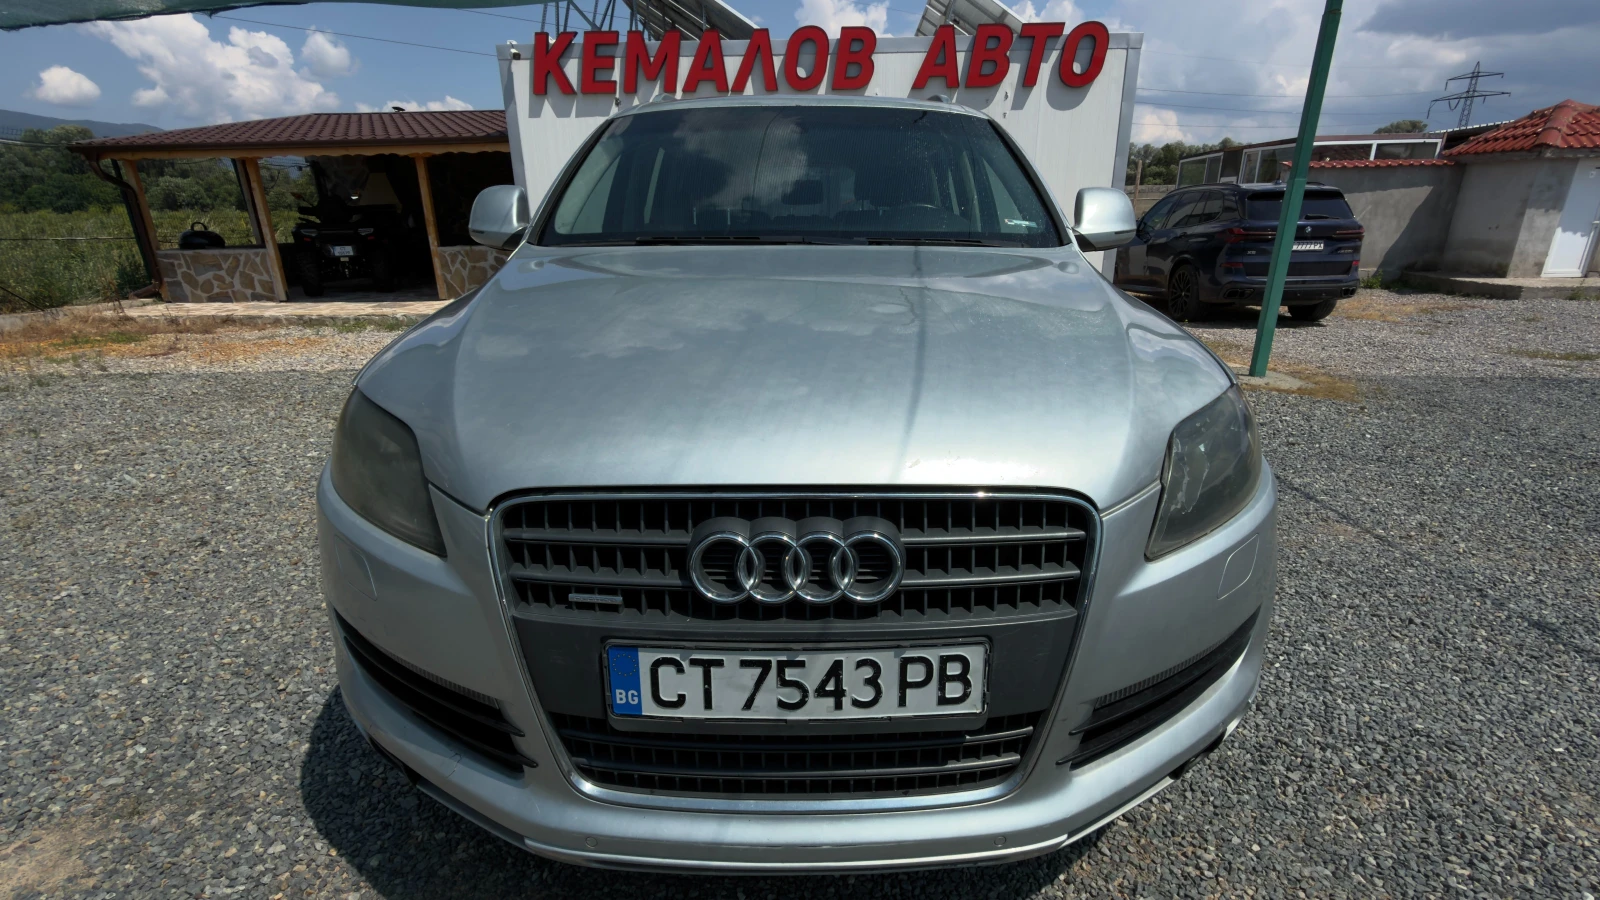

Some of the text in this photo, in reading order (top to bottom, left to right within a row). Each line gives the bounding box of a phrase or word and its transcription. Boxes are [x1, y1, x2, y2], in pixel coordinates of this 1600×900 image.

[532, 21, 1110, 95] КЕМАЛОВ АВТО
[615, 688, 639, 705] BG
[650, 653, 973, 711] CT 7543 PB
